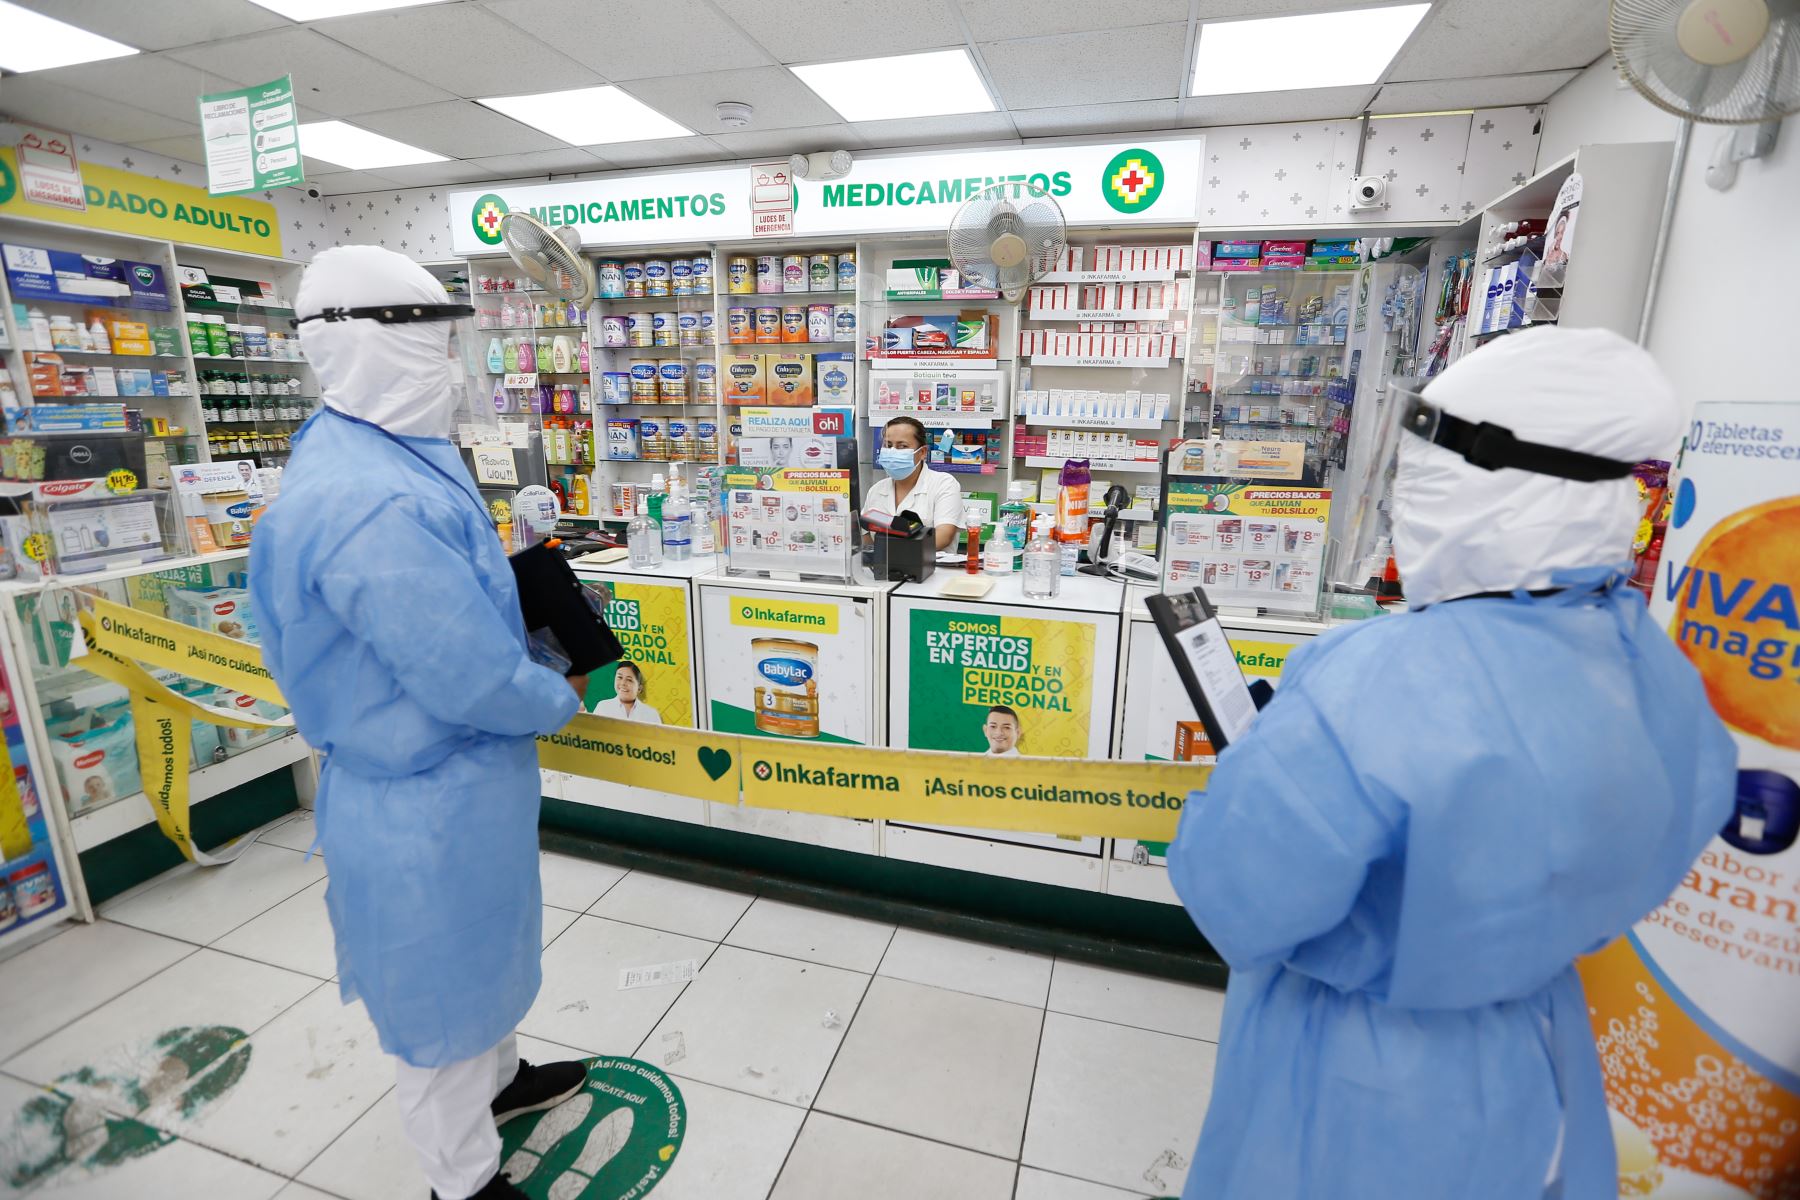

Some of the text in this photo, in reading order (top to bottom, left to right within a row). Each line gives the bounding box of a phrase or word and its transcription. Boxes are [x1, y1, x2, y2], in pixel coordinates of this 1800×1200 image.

[822, 171, 1072, 208] MEDICAMENTOS
[83, 184, 271, 238] DADO ADULTO
[529, 192, 726, 227] MEDICAMENTOS
[760, 214, 786, 223] LUCES DE
[755, 223, 791, 232] EMERGENCIA
[136, 271, 152, 279] VICK
[601, 273, 621, 281] NAN
[814, 329, 820, 337] 2
[748, 416, 810, 427] REALIZA AQUÍ
[1706, 421, 1783, 441] Tabletas
[43, 483, 86, 493] Colgate
[203, 474, 236, 483] DEFENSA
[1250, 491, 1291, 499] ¡PRECIOS
[1271, 507, 1318, 515] BOLSILLO!
[1219, 534, 1233, 543] 15
[1248, 570, 1261, 580] 13
[754, 607, 826, 626] Inkafarma
[641, 623, 648, 632] Y
[652, 624, 664, 634] EN
[948, 621, 998, 635] SOMOS
[113, 619, 177, 652] Inkafarma
[208, 653, 227, 667] nos
[926, 630, 1029, 656] EXPERTOS
[624, 647, 676, 666] SONAL
[929, 647, 1062, 677] EN SALUD Y EN
[1236, 650, 1284, 669] kafar
[763, 663, 807, 678] BabyLac
[965, 670, 1063, 694] CUIDADO
[766, 694, 773, 706] 3
[964, 686, 1073, 713] PERSONAL
[156, 717, 174, 756] todos!
[551, 732, 625, 759] cuidamos
[627, 744, 677, 766] todos!
[775, 762, 1188, 811] Inkafarma ¡Así nos cuidamos todo
[1701, 849, 1784, 888] abor
[1697, 909, 1800, 954] de azú
[588, 1079, 647, 1105] UBÍCATE AQUÍ
[589, 1059, 682, 1139] ¡Así nos cuidamos todos!
